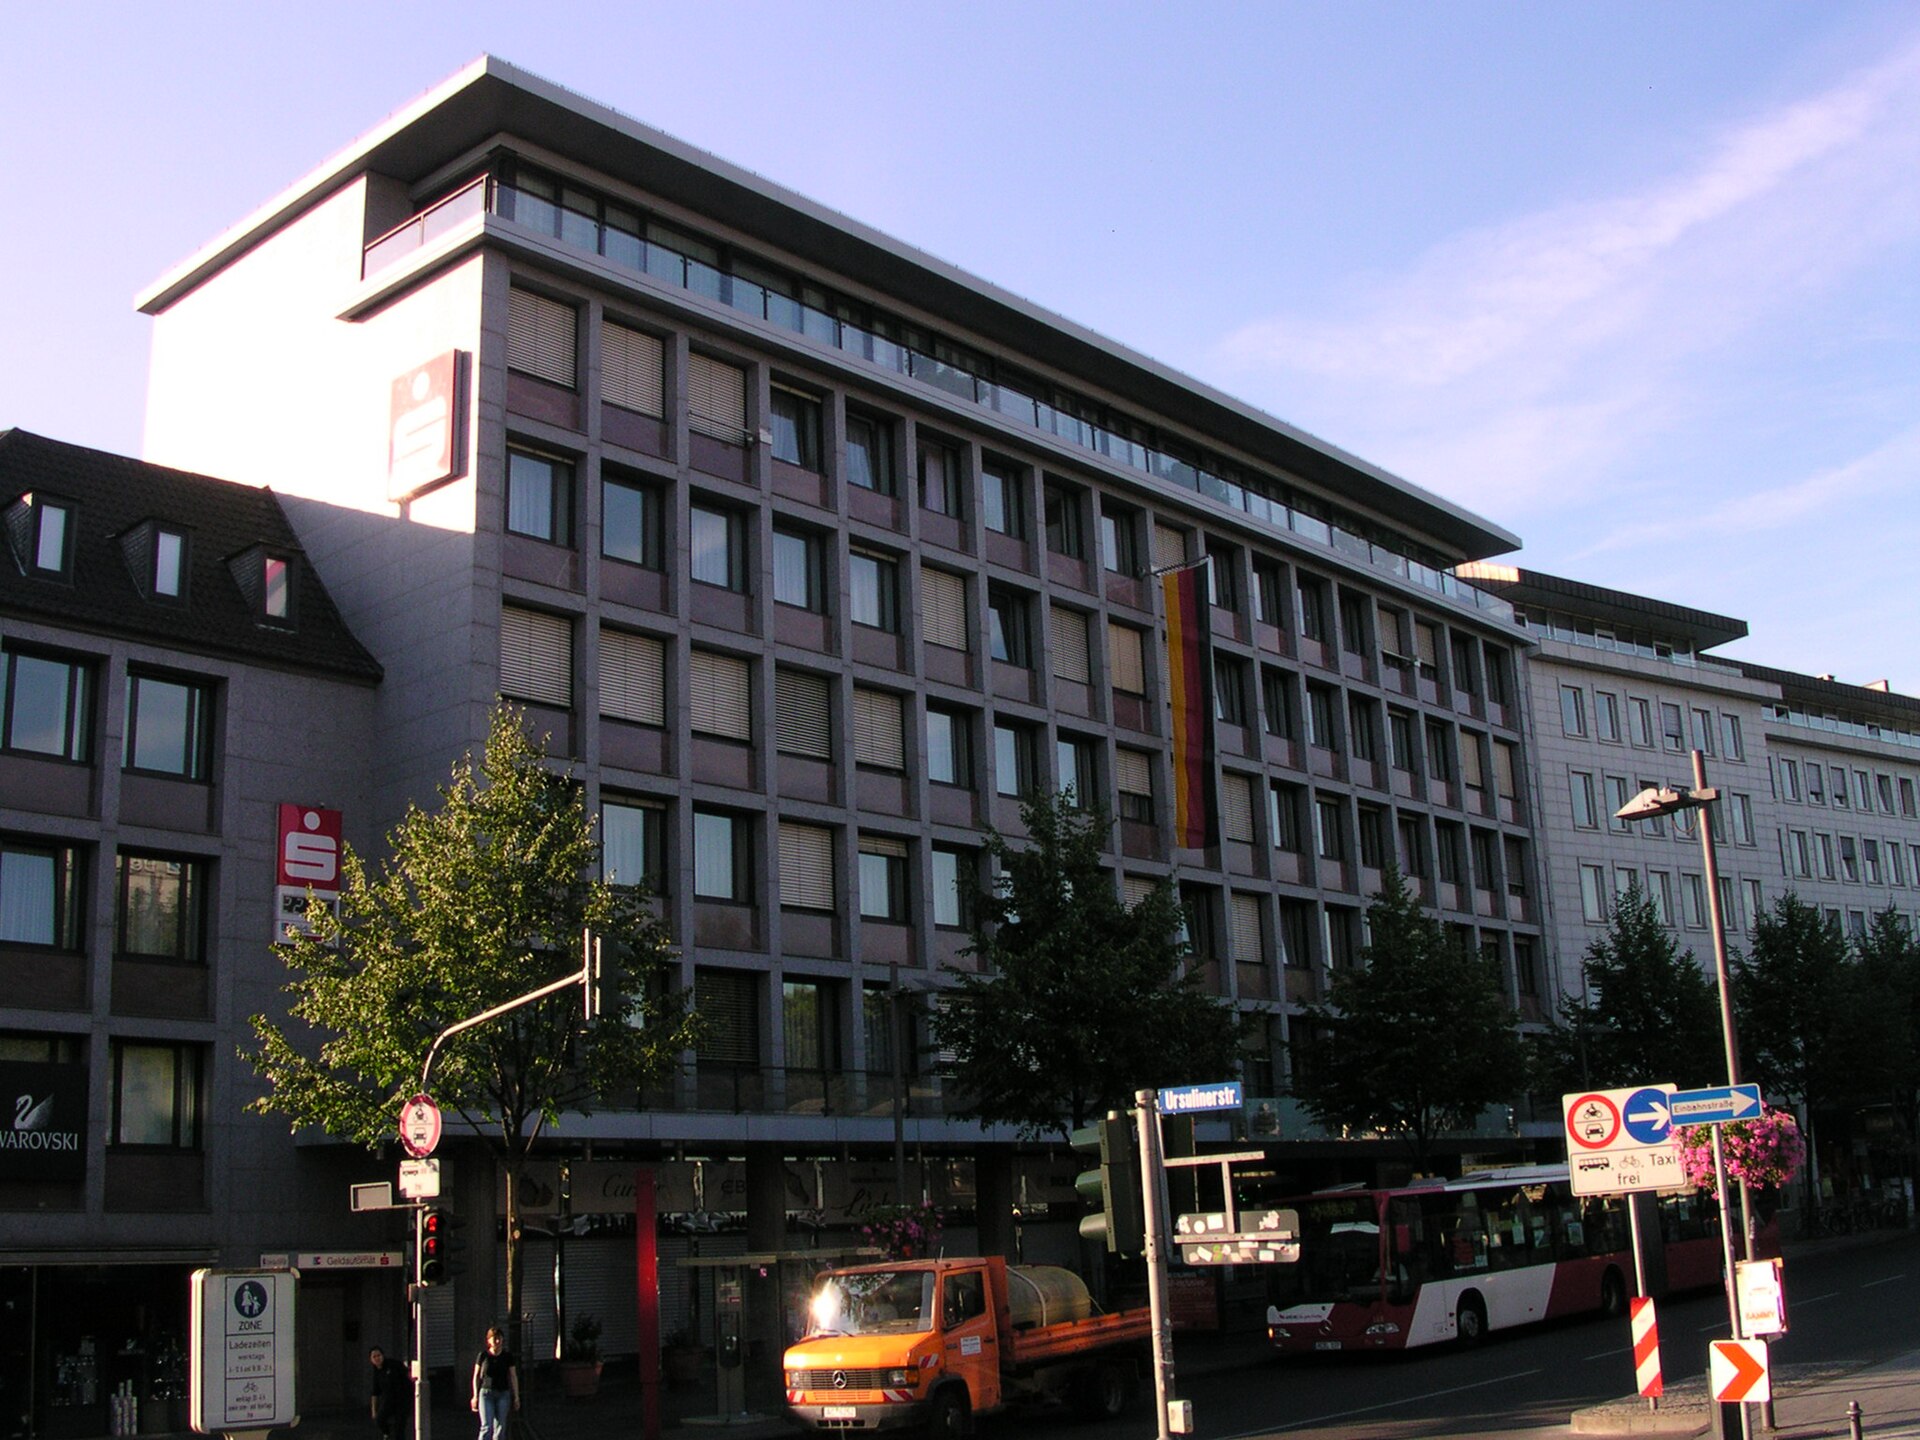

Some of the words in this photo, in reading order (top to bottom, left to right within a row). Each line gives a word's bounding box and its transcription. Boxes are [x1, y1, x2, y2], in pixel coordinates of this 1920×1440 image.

[1164, 1086, 1240, 1110] Ursulinerstr.
[1673, 1100, 1735, 1113] Einbahnstraße
[1649, 1153, 1676, 1166] Taxi
[1617, 1173, 1641, 1185] frei
[326, 1254, 376, 1266] Geldautomat
[238, 1320, 263, 1331] ZONE
[229, 1340, 272, 1350] Ladezeiten
